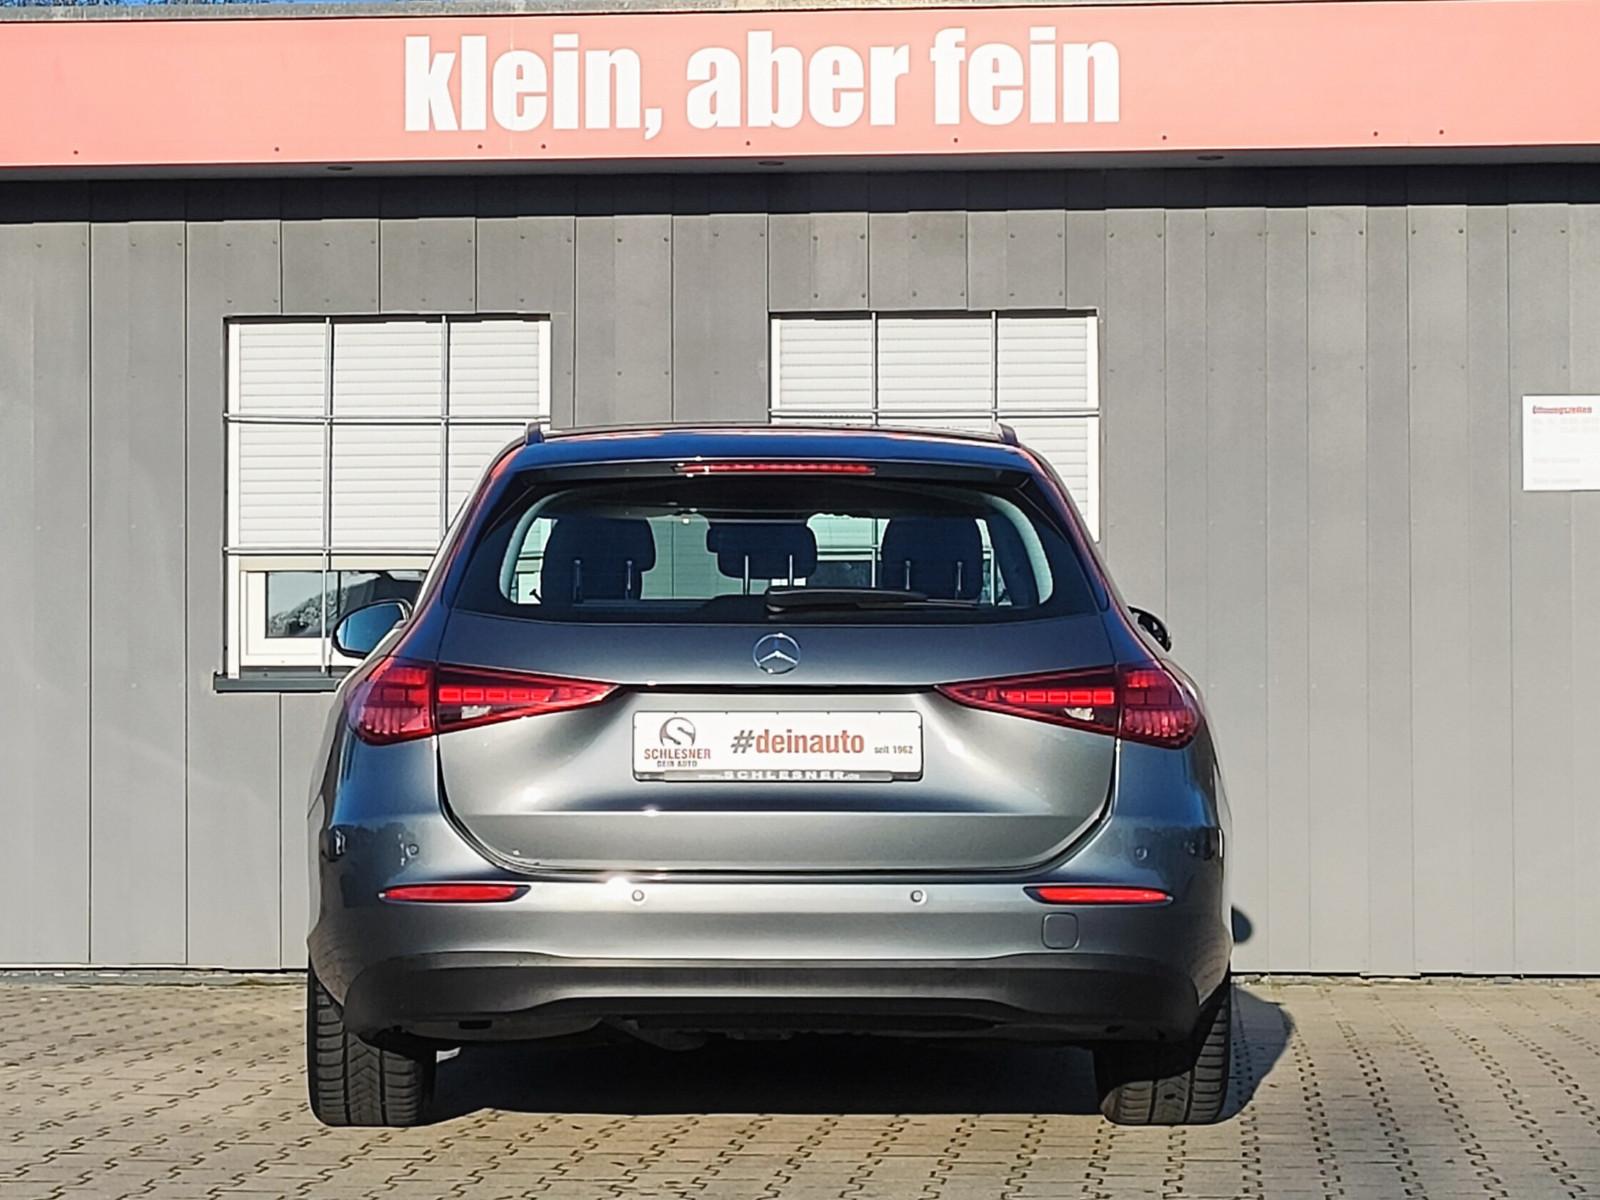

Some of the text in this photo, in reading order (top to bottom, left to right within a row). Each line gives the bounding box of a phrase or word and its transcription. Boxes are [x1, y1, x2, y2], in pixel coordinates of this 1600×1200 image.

[404, 26, 1120, 140] klein, aber fein
[730, 728, 865, 754] #deinauto
[644, 748, 711, 760] SCHLESNER
[892, 745, 913, 754] 1962
[656, 760, 698, 768] DEIN AUTO
